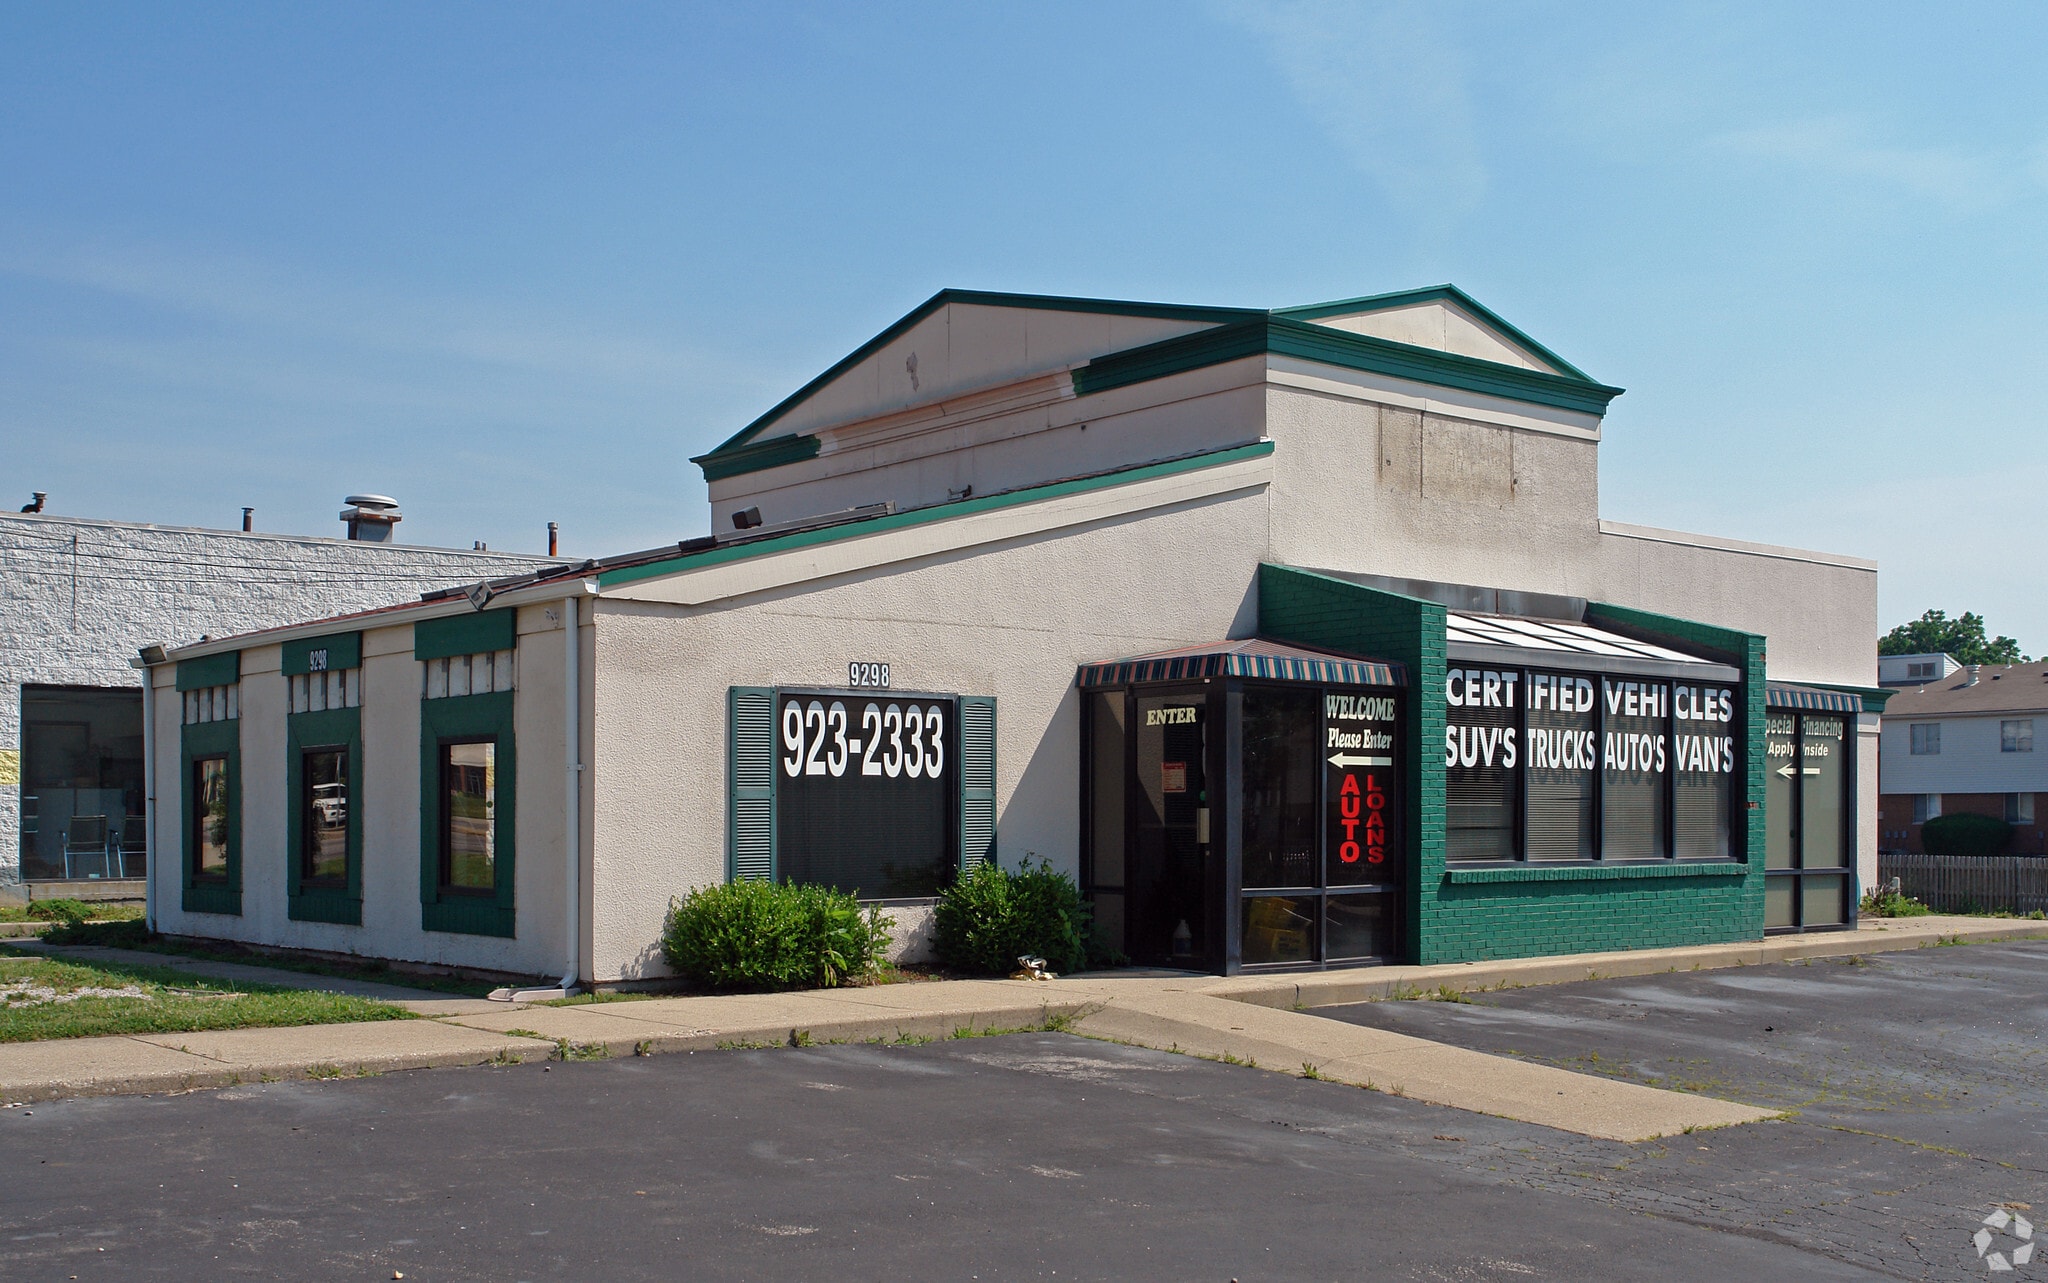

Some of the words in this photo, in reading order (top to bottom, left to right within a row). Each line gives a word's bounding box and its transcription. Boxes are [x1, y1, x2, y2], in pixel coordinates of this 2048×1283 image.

[310, 649, 328, 671] 9298
[850, 662, 890, 687] 9298
[1146, 706, 1197, 726] ENTER
[1326, 694, 1396, 722] WELCOME
[1327, 727, 1362, 749] Please
[1362, 728, 1393, 750] Enter
[1765, 714, 1796, 738] pecial
[782, 700, 945, 779] 923-2333
[1446, 725, 1517, 769] SUV'S
[1527, 728, 1596, 770] TRUCKS
[1604, 731, 1666, 773] AUTO'S
[1675, 734, 1734, 773] VAN'S
[1767, 741, 1796, 758] Apply
[1339, 773, 1361, 864] AUTO
[1365, 774, 1386, 864] LOANS
